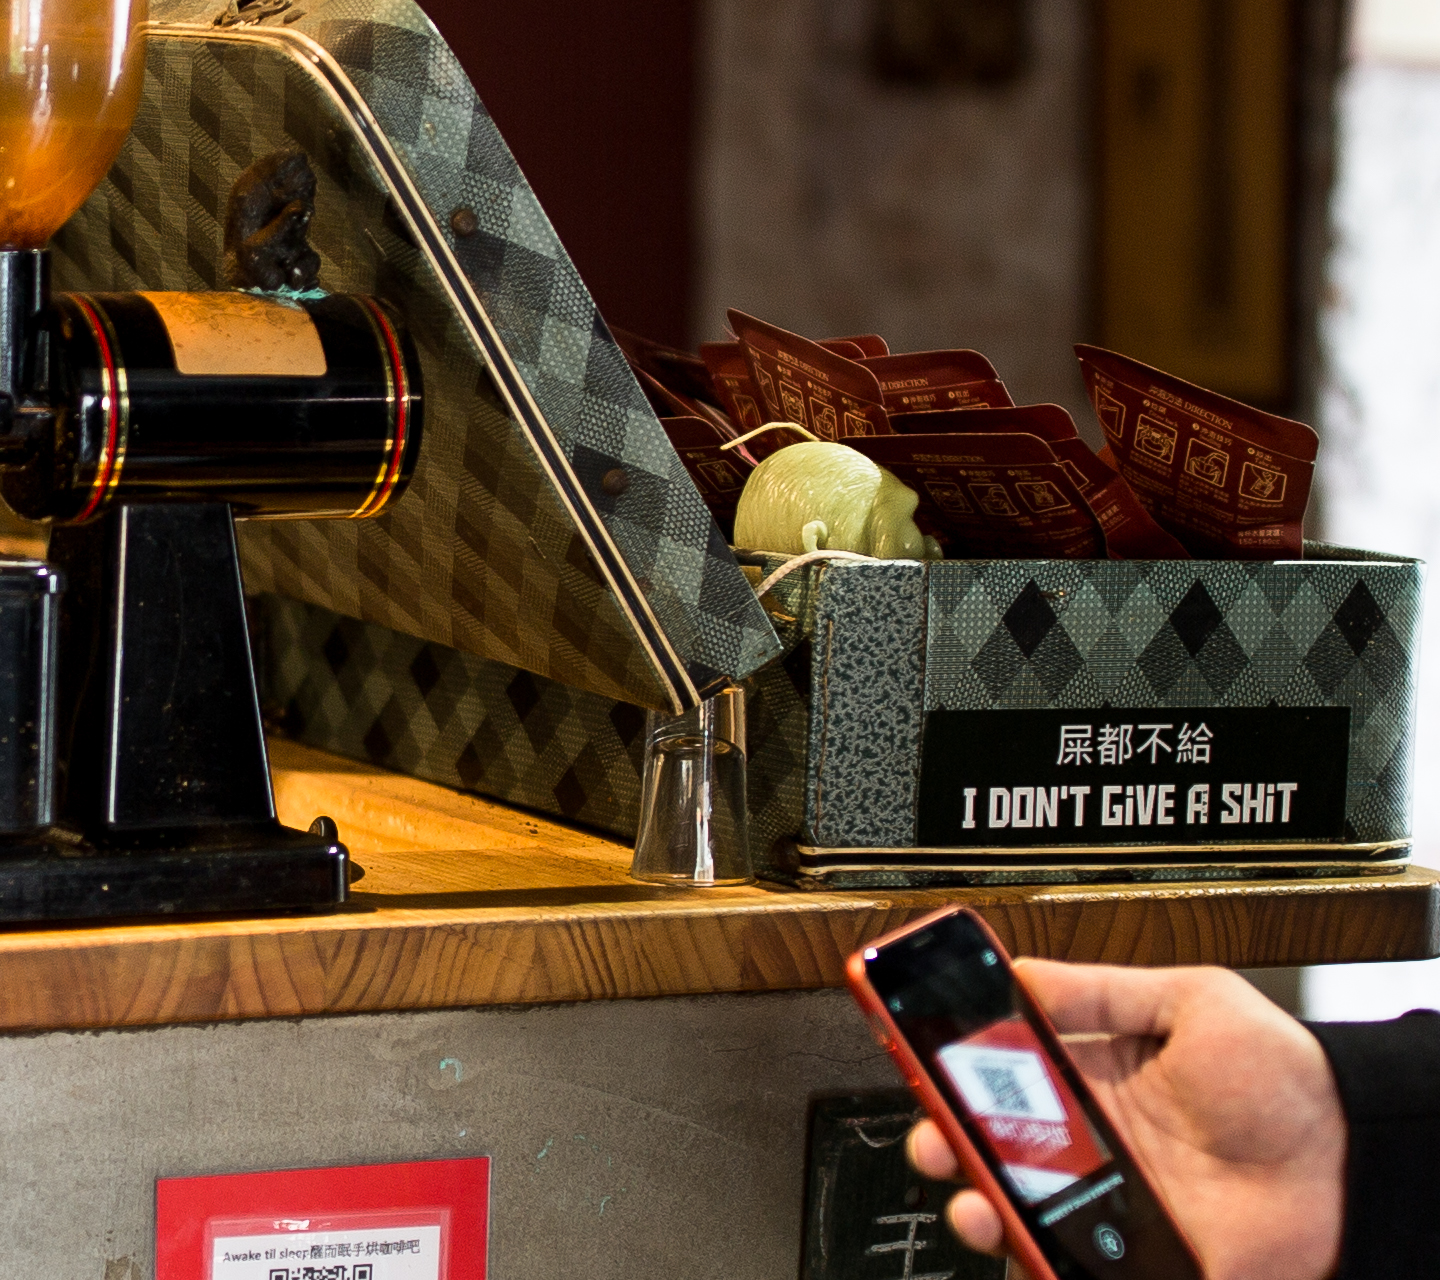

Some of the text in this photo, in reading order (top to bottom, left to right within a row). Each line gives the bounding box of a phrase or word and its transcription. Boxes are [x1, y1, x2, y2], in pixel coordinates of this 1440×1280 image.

[887, 377, 929, 391] DIRECTION
[1184, 401, 1233, 430] DIRECTION
[1056, 722, 1214, 766] 屎都不給
[962, 787, 977, 829] I
[988, 785, 1091, 829] DON'T
[1186, 783, 1210, 824] A
[223, 1249, 262, 1263] Awake
[264, 1248, 276, 1260] til
